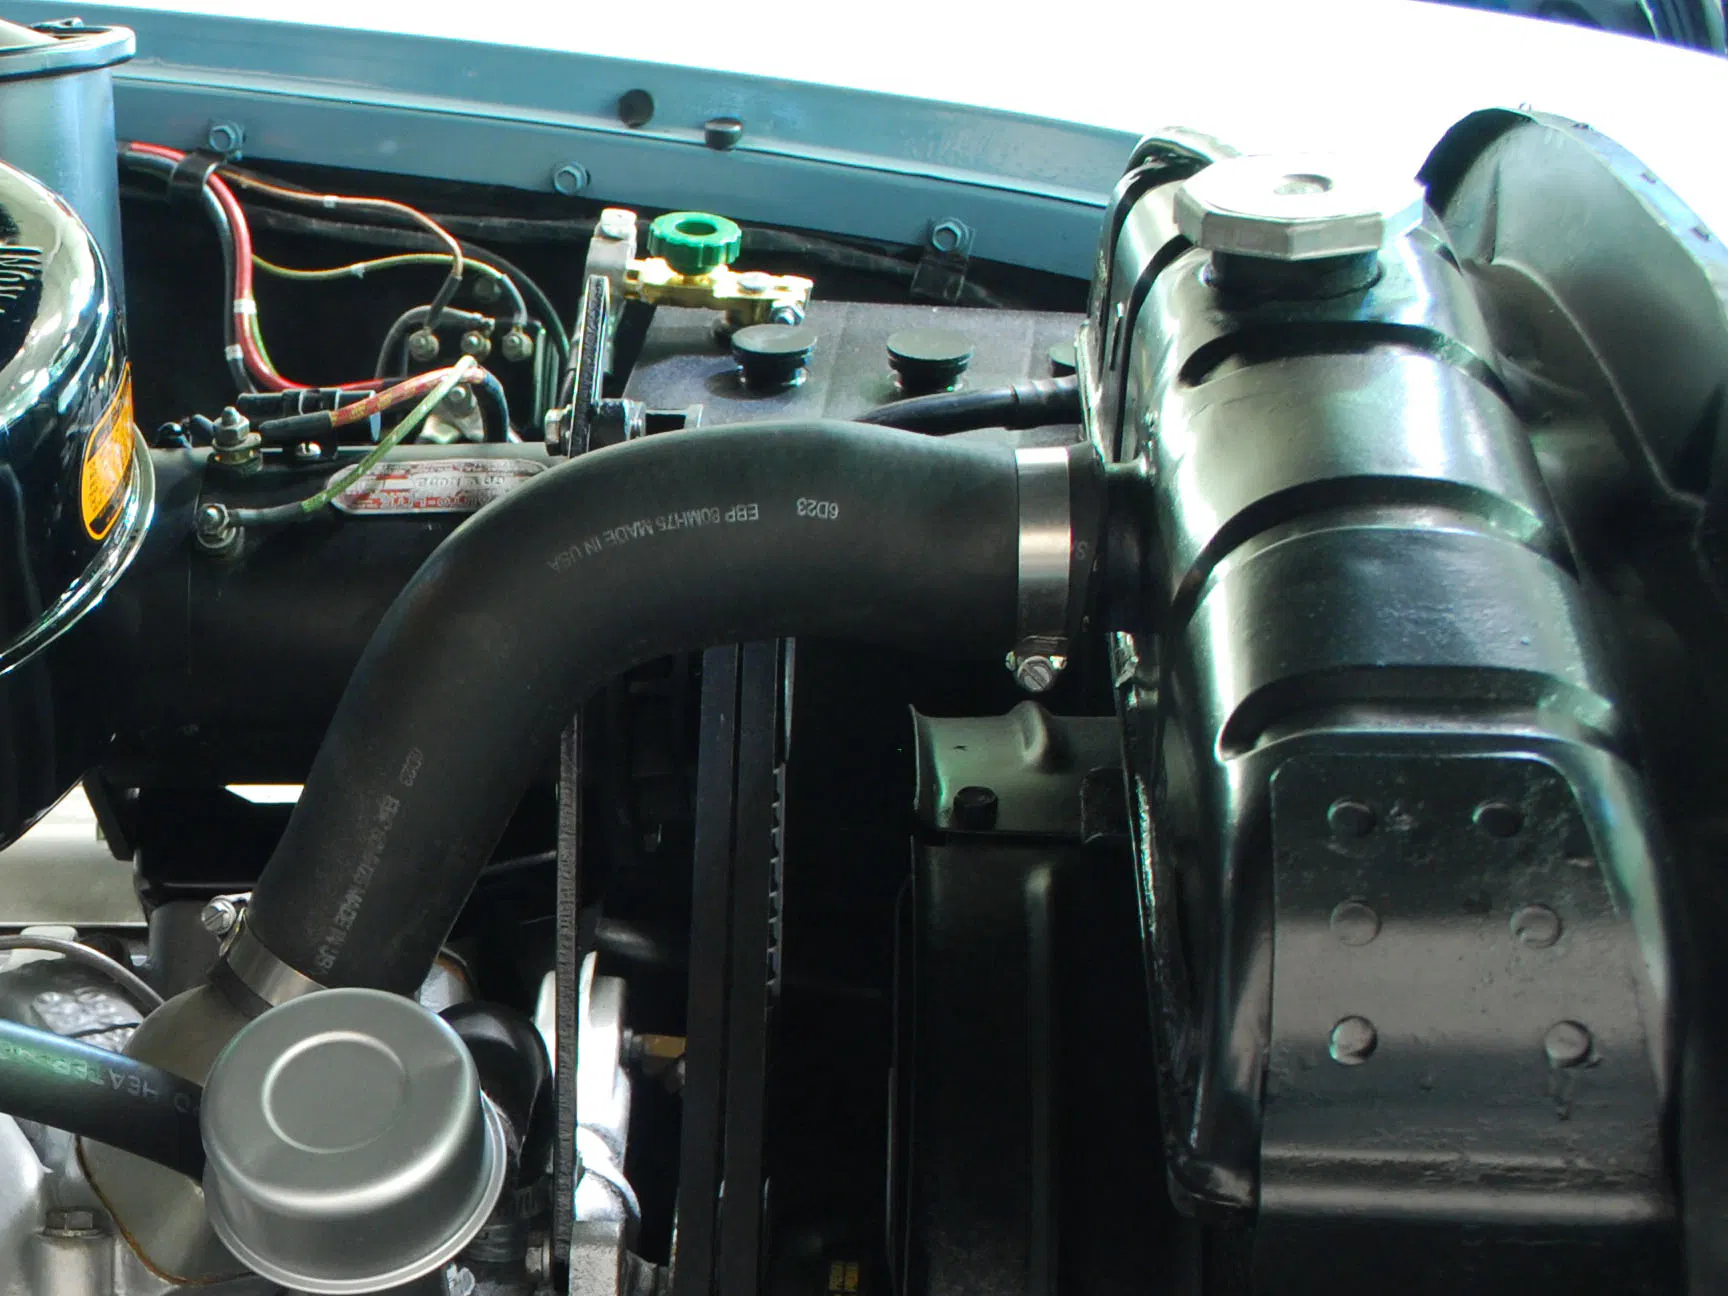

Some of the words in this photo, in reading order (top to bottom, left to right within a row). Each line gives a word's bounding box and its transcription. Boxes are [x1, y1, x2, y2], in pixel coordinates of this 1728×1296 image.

[725, 503, 760, 522] EBP
[796, 497, 839, 520] 6D23
[603, 519, 654, 546] MADE
